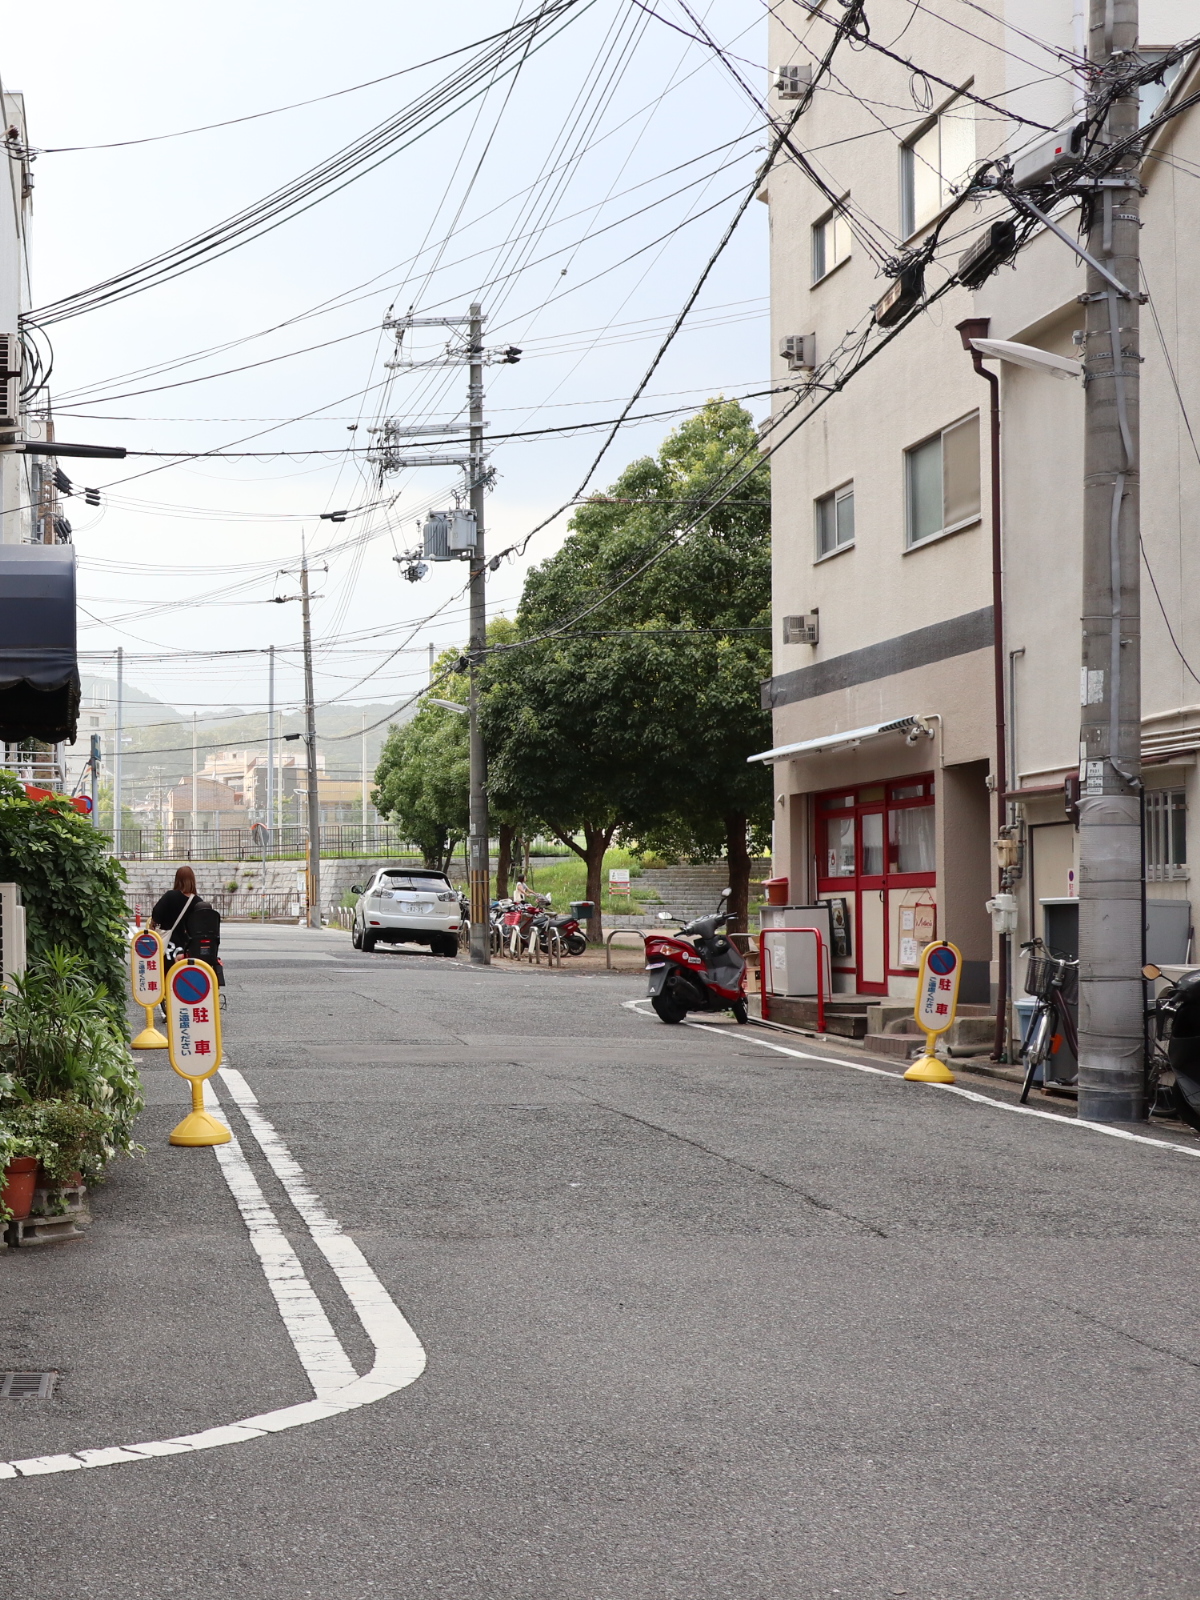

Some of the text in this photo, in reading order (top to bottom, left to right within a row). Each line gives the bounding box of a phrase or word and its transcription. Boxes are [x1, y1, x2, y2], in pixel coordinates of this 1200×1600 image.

[147, 960, 158, 991] 駐車
[935, 978, 951, 1016] 駐車
[179, 1008, 191, 1056] ご遠慮ください
[192, 1007, 211, 1055] 駐車
